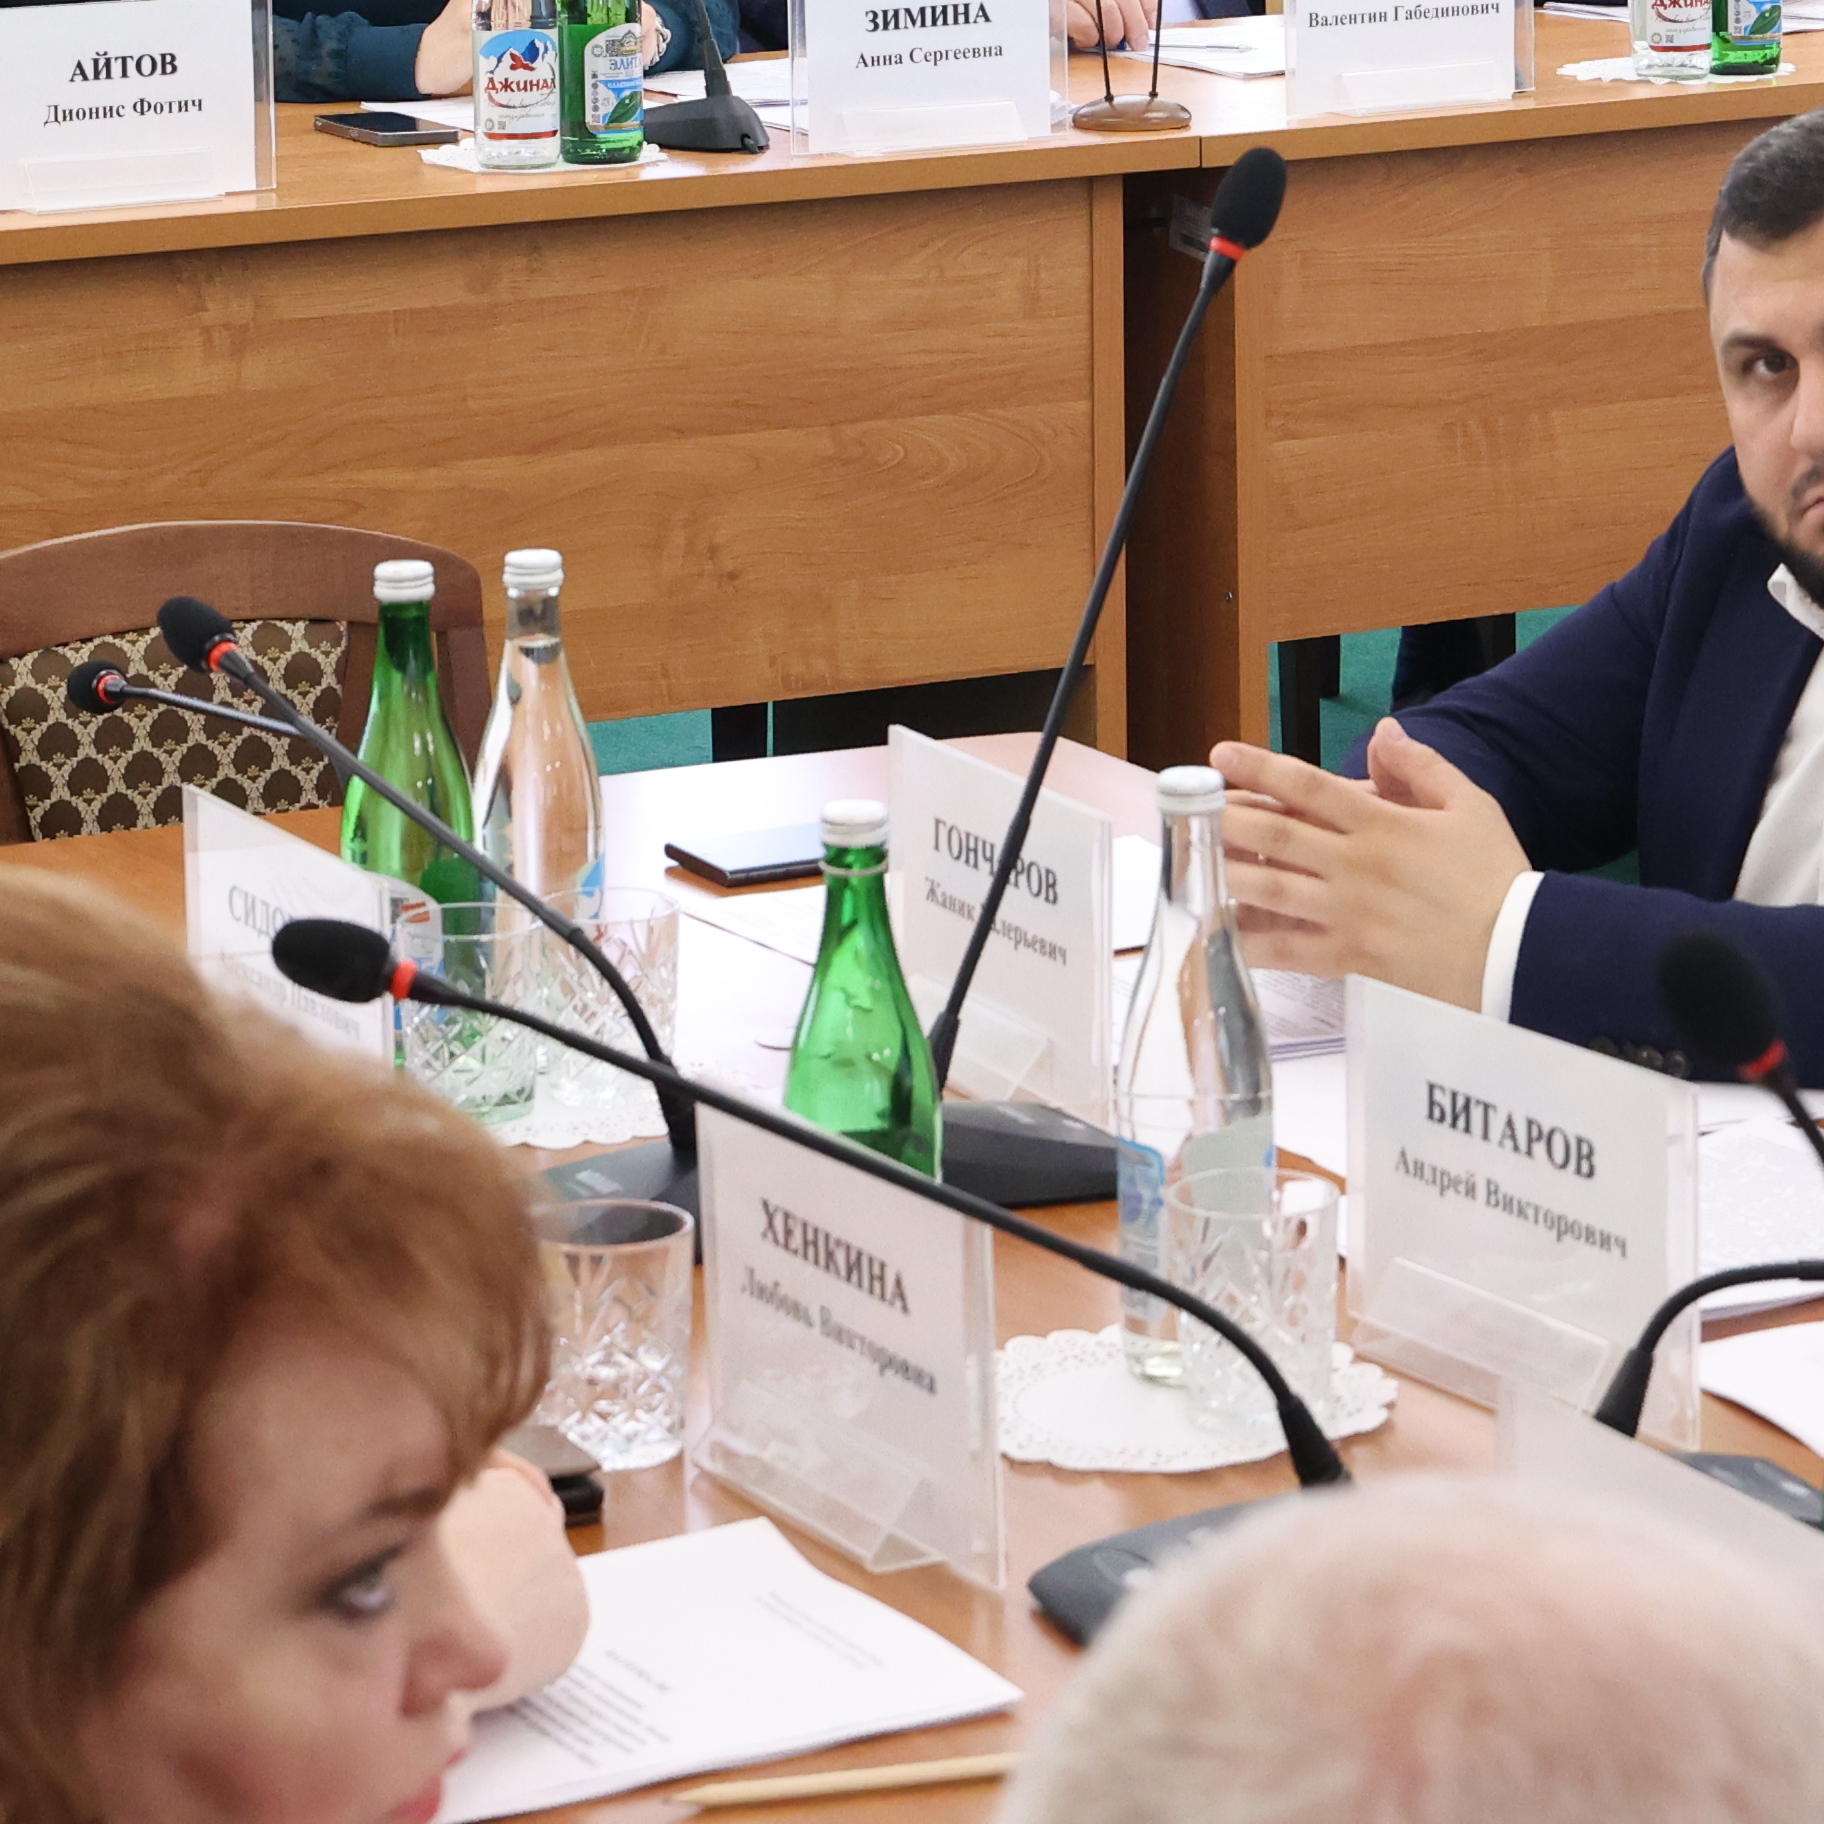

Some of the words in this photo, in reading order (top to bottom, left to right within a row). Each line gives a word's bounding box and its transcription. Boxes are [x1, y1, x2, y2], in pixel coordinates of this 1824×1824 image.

[864, 1, 993, 33] ЗИМИНА
[1308, 10, 1388, 28] Валентин
[1393, 2, 1501, 22] Габединович
[69, 50, 179, 82] АЙТОВ
[855, 52, 904, 69] Анна
[908, 44, 1004, 67] Сергеевна
[43, 103, 126, 127] Дионис
[132, 97, 204, 116] Фотич
[925, 876, 977, 922] Жаник
[1425, 1078, 1596, 1181] БИТАРОВ
[1394, 1146, 1478, 1202] Андрей
[1484, 1176, 1628, 1259] Викторович
[760, 1197, 912, 1316] ХЕНКИНА
